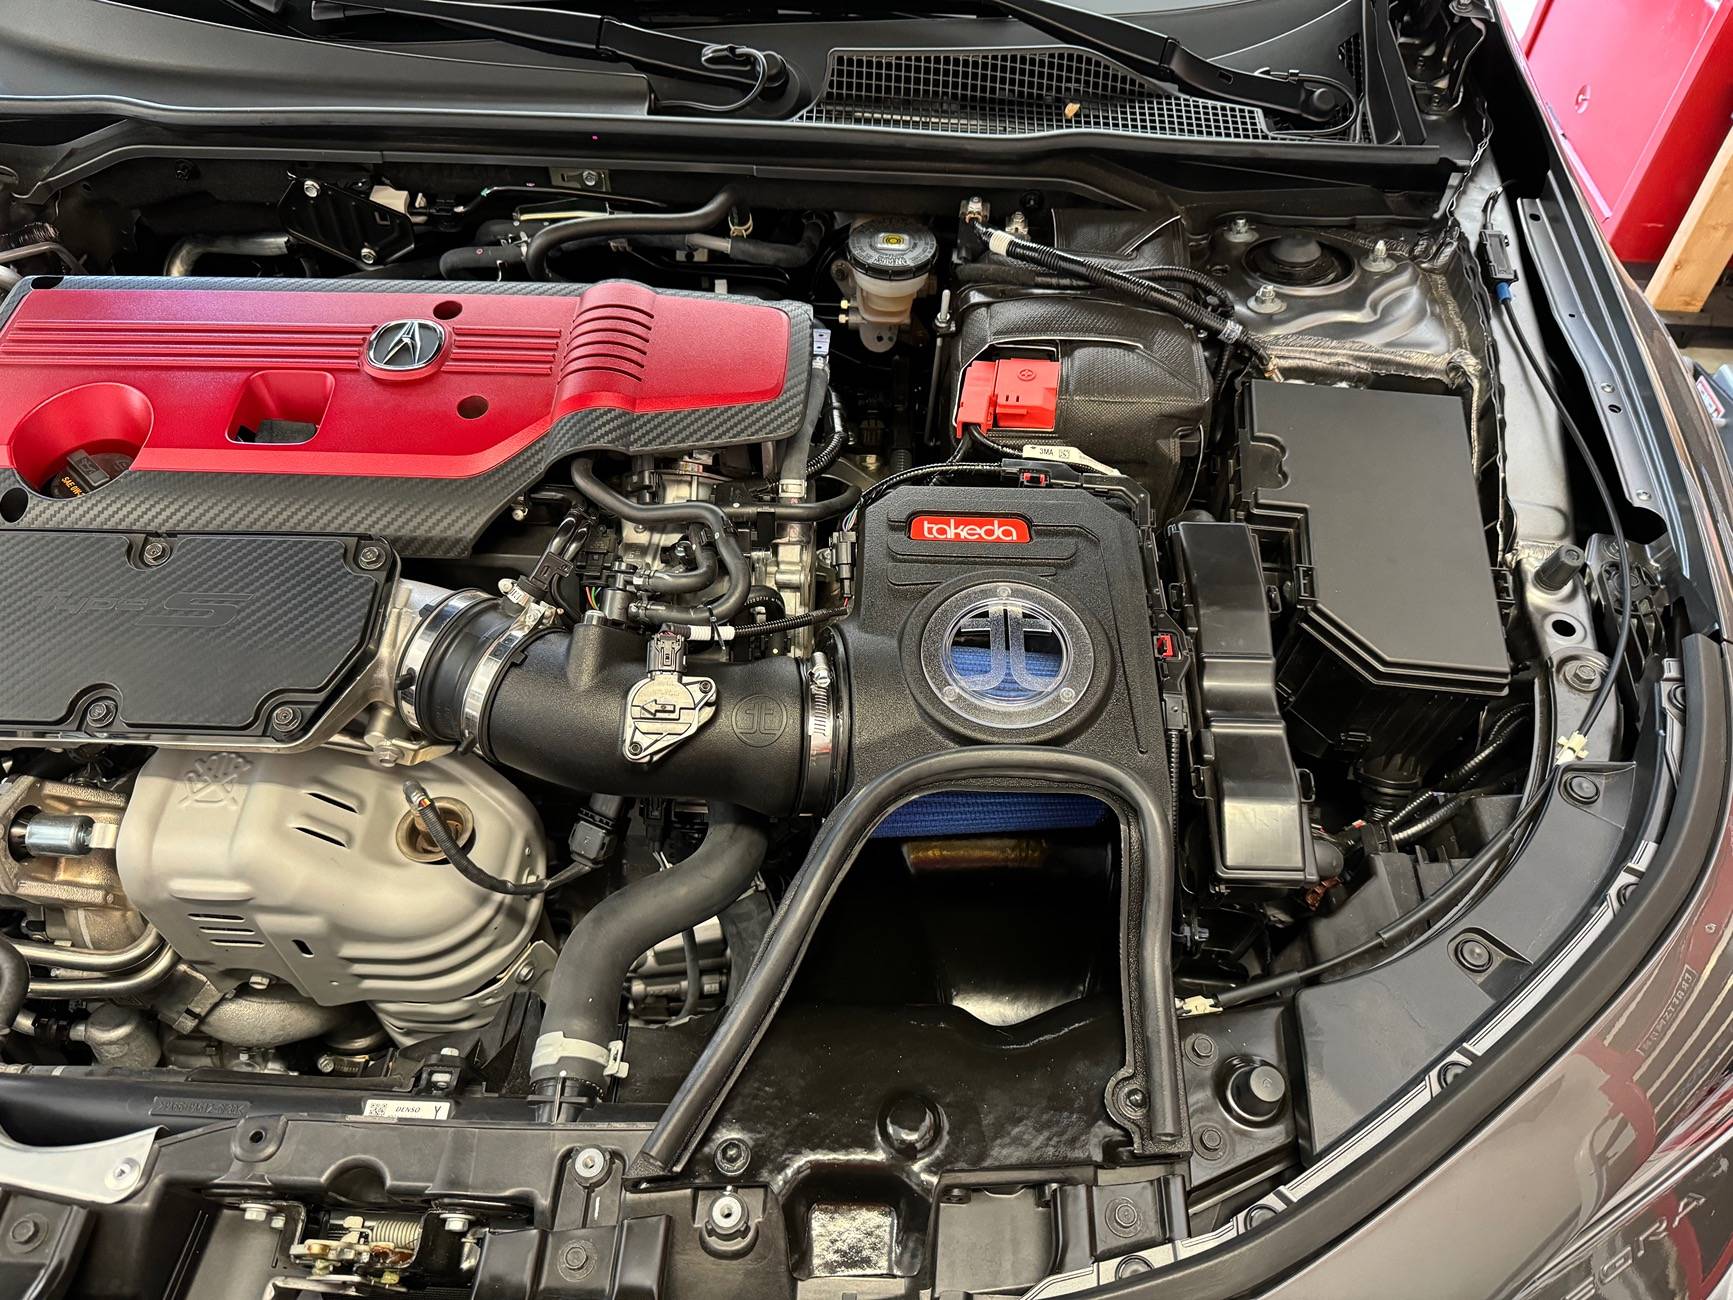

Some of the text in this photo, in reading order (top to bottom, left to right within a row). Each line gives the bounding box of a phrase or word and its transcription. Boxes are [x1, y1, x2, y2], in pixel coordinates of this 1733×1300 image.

[1039, 447, 1054, 456] 3MA
[61, 476, 76, 488] SAE
[923, 518, 1017, 541] takeda
[133, 591, 256, 627] S
[434, 1105, 442, 1120] Y
